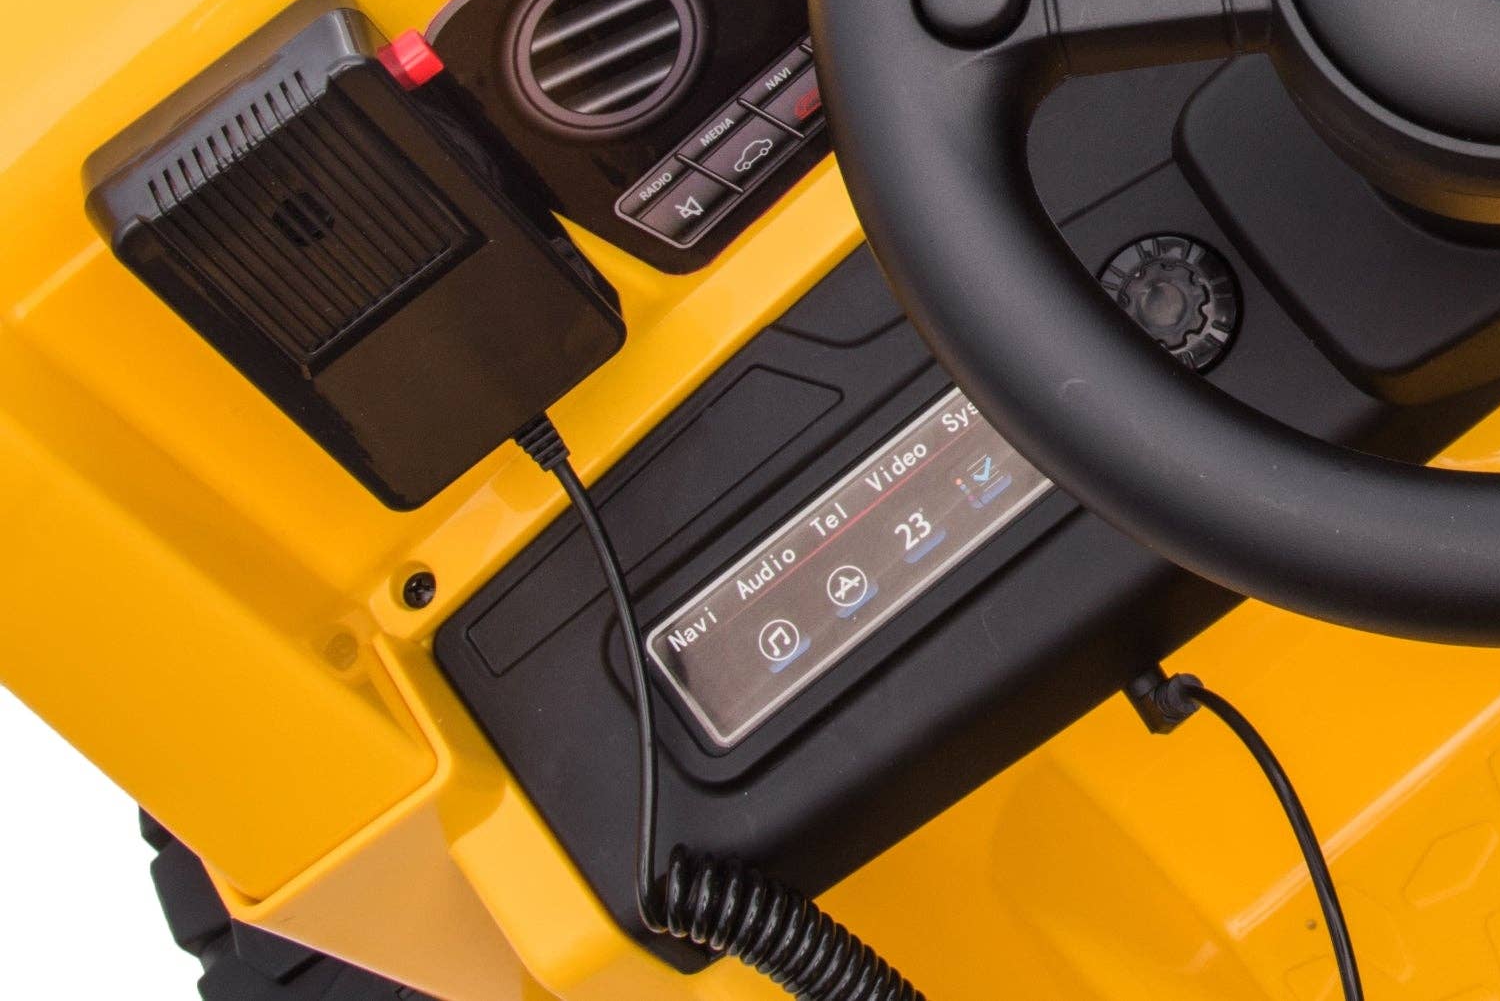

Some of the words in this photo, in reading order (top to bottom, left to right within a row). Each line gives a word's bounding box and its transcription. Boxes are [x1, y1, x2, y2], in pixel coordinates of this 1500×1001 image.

[764, 67, 792, 91] NAVI
[699, 117, 735, 147] MEDIA
[638, 172, 673, 201] RADIO
[667, 605, 718, 652] Navi
[735, 546, 797, 600] Audio
[809, 502, 849, 537] Tel
[864, 441, 928, 492] Video
